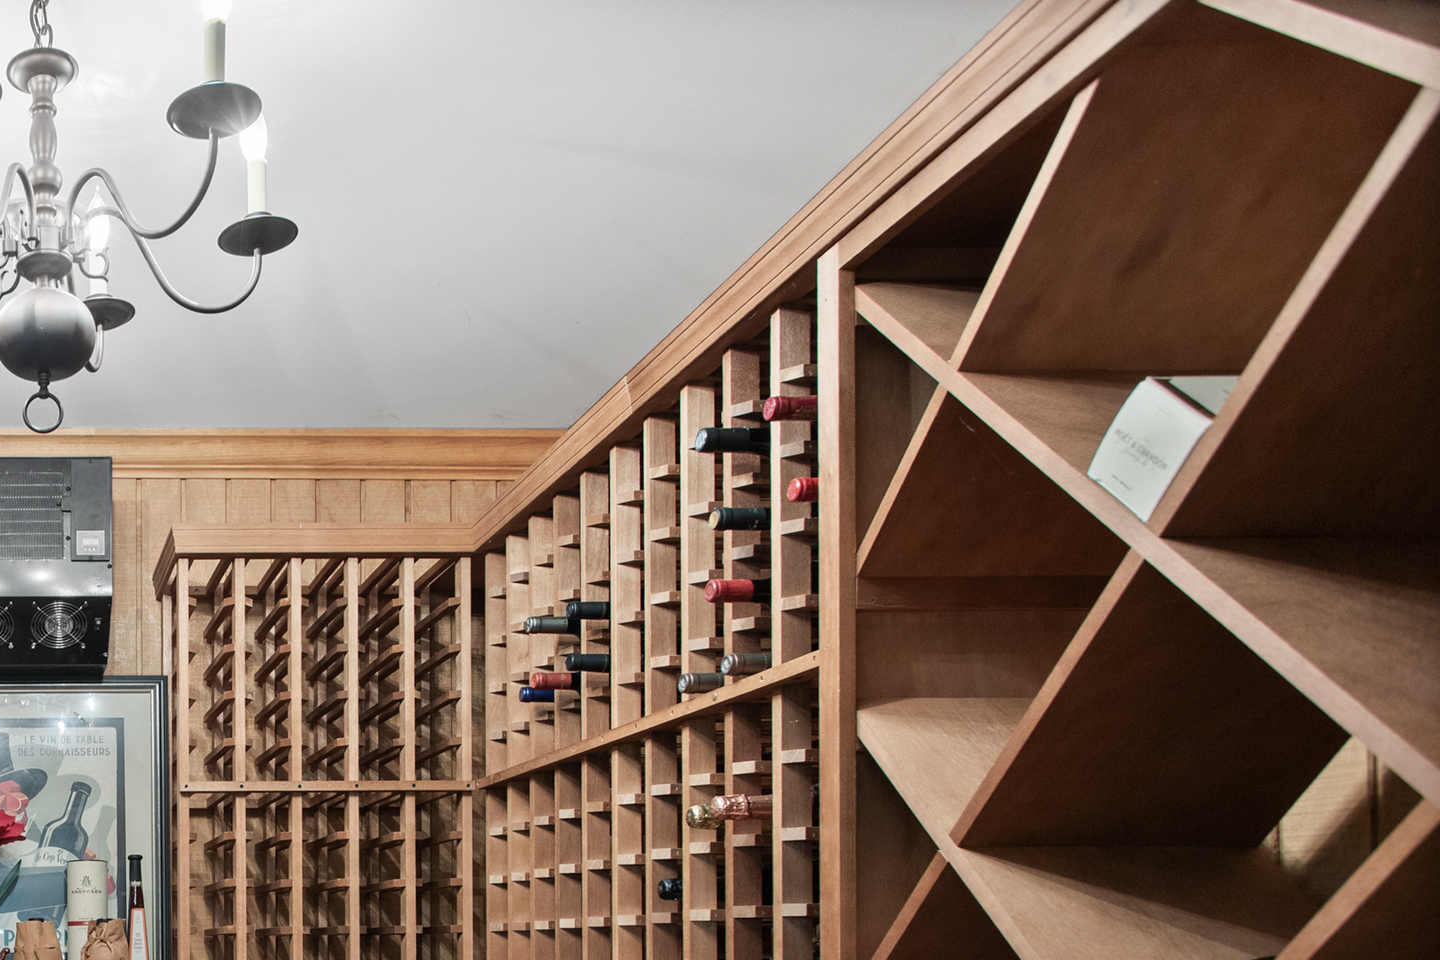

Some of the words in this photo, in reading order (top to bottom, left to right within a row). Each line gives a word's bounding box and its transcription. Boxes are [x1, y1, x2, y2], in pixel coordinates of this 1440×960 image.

[24, 735, 35, 744] LE
[39, 735, 57, 744] VIN
[61, 735, 71, 744] DE
[76, 735, 104, 744] TABLE
[17, 747, 35, 757] DES
[40, 747, 111, 757] CONNAISSEURS
